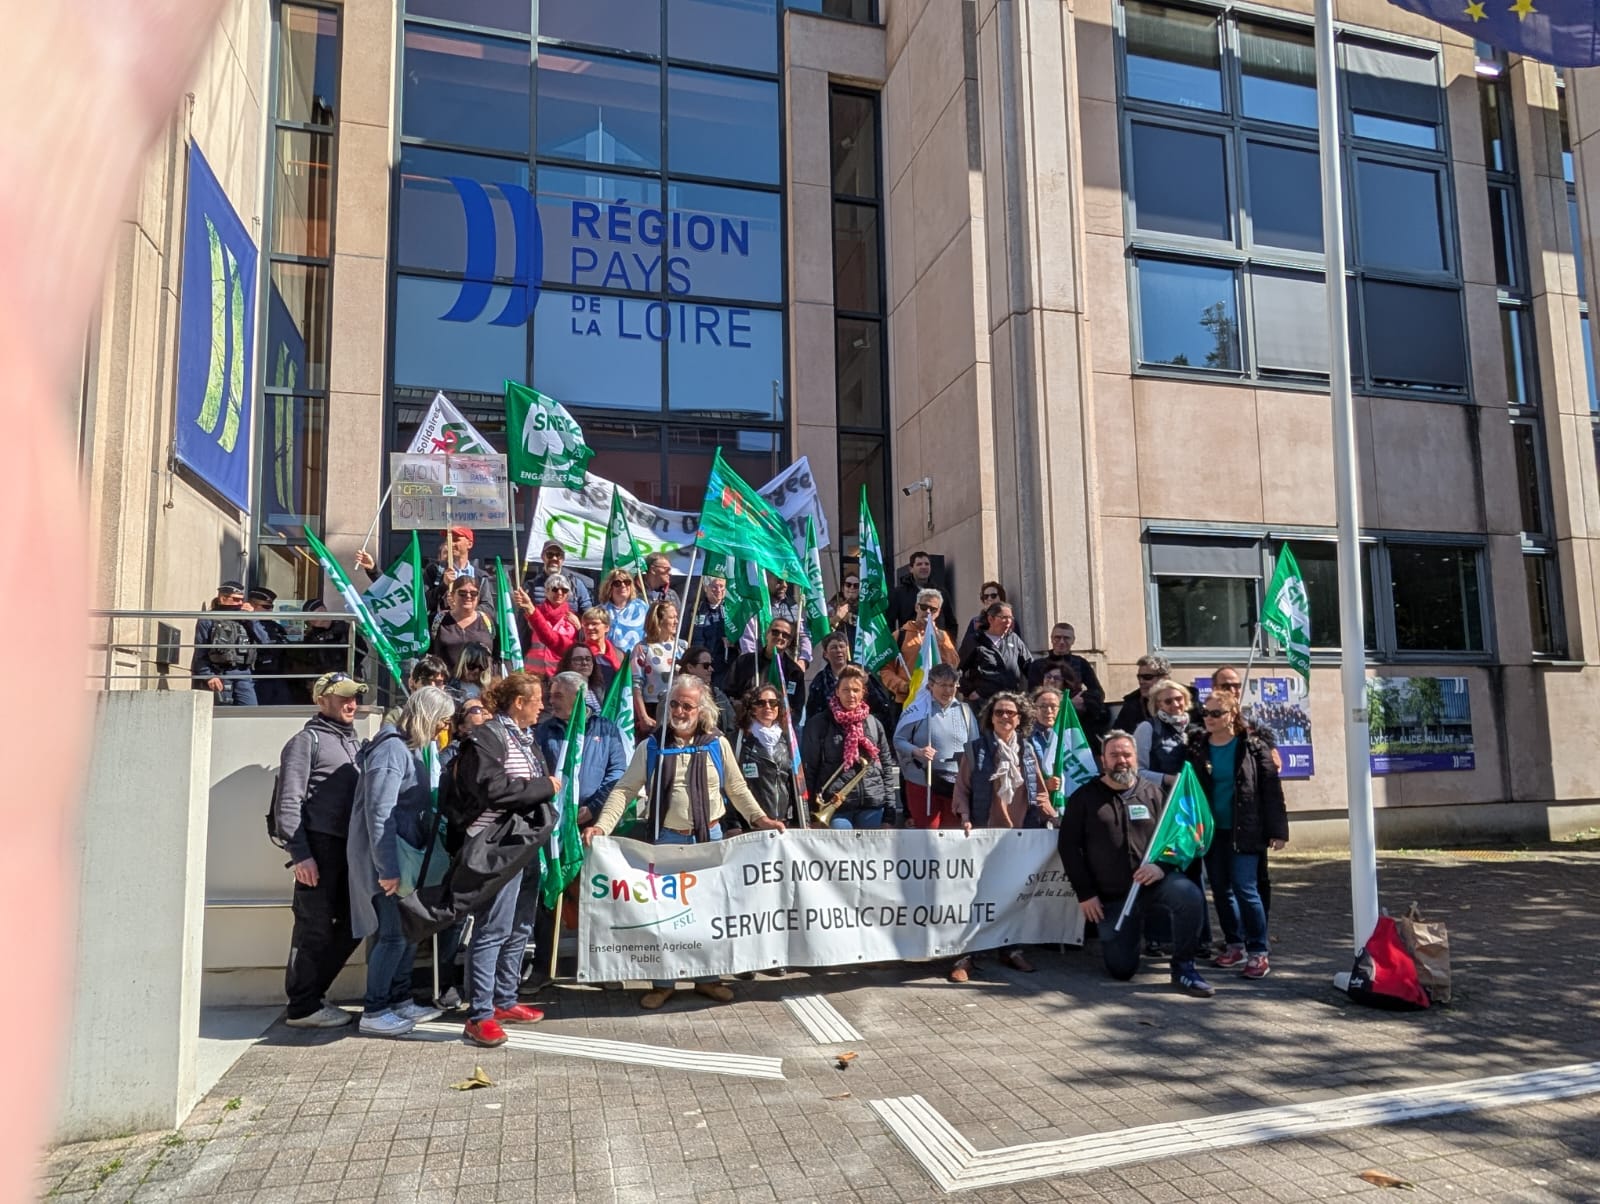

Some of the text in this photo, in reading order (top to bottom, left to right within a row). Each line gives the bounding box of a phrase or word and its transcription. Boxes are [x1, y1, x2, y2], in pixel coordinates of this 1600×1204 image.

[571, 198, 749, 256] RÉGION
[571, 247, 692, 296] PAYS
[571, 295, 601, 313] DE
[571, 300, 751, 348] LA LOIRE
[417, 406, 441, 454] Solidaires
[403, 463, 440, 481] NON
[591, 863, 697, 905] snetap
[742, 858, 974, 887] DES MOYENS POUR UN
[1025, 870, 1068, 886] SNETA
[1034, 889, 1044, 897] de
[1046, 888, 1054, 897] la
[711, 902, 995, 940] SERVICE PUBLIC DE QUALITE
[589, 941, 702, 953] Enseignement Agricole
[630, 954, 661, 963] Public
